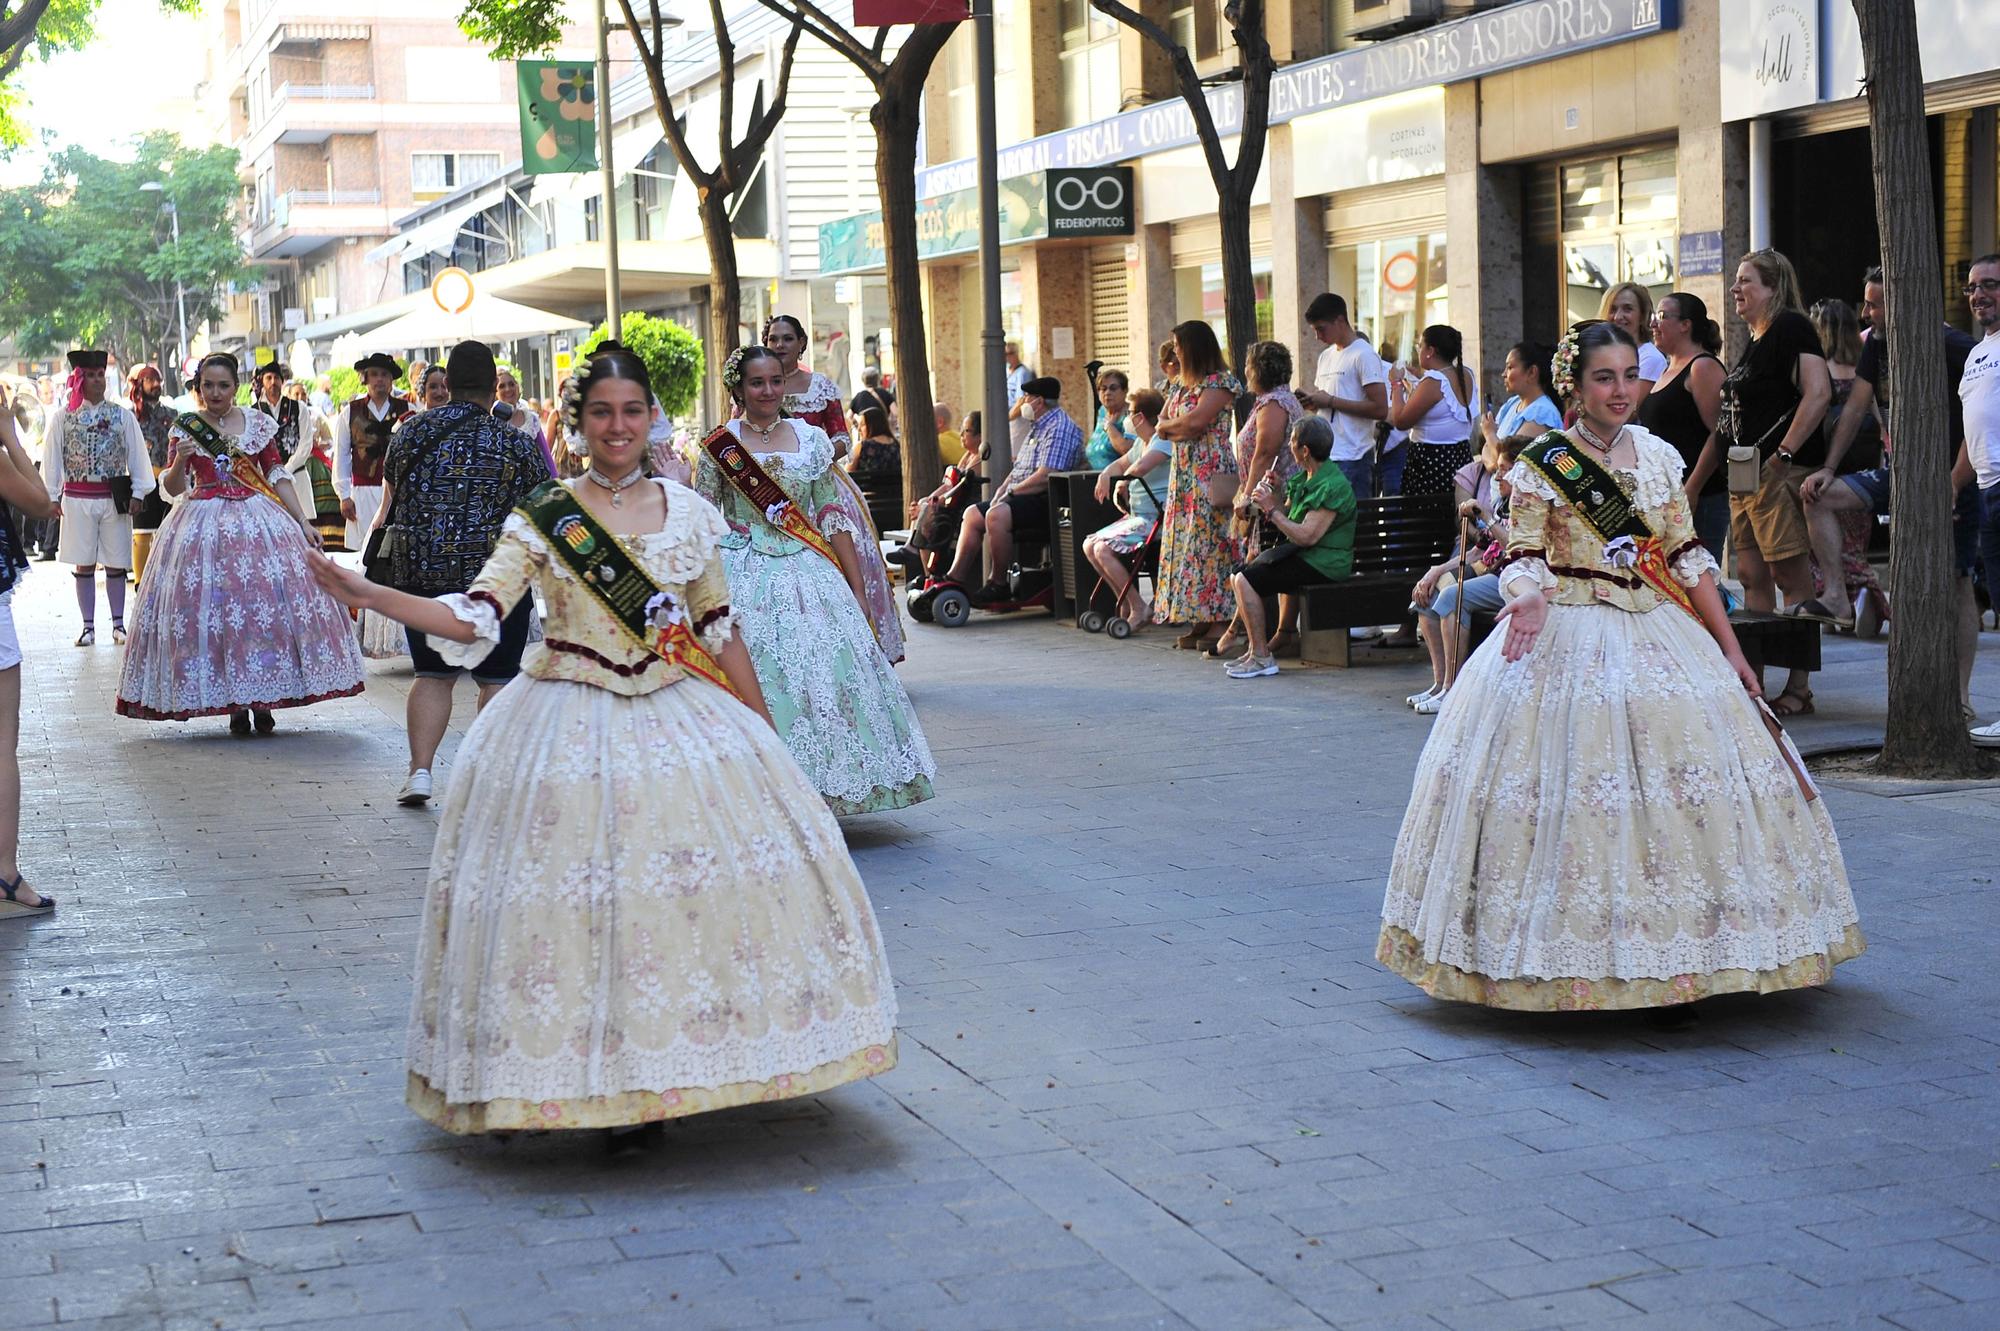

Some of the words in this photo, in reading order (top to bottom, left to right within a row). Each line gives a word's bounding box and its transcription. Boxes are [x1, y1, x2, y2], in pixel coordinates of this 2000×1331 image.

[1066, 120, 1124, 167] FISCAL
[1468, 0, 1613, 68] ASESORES
[1575, 474, 1596, 495] 2022
